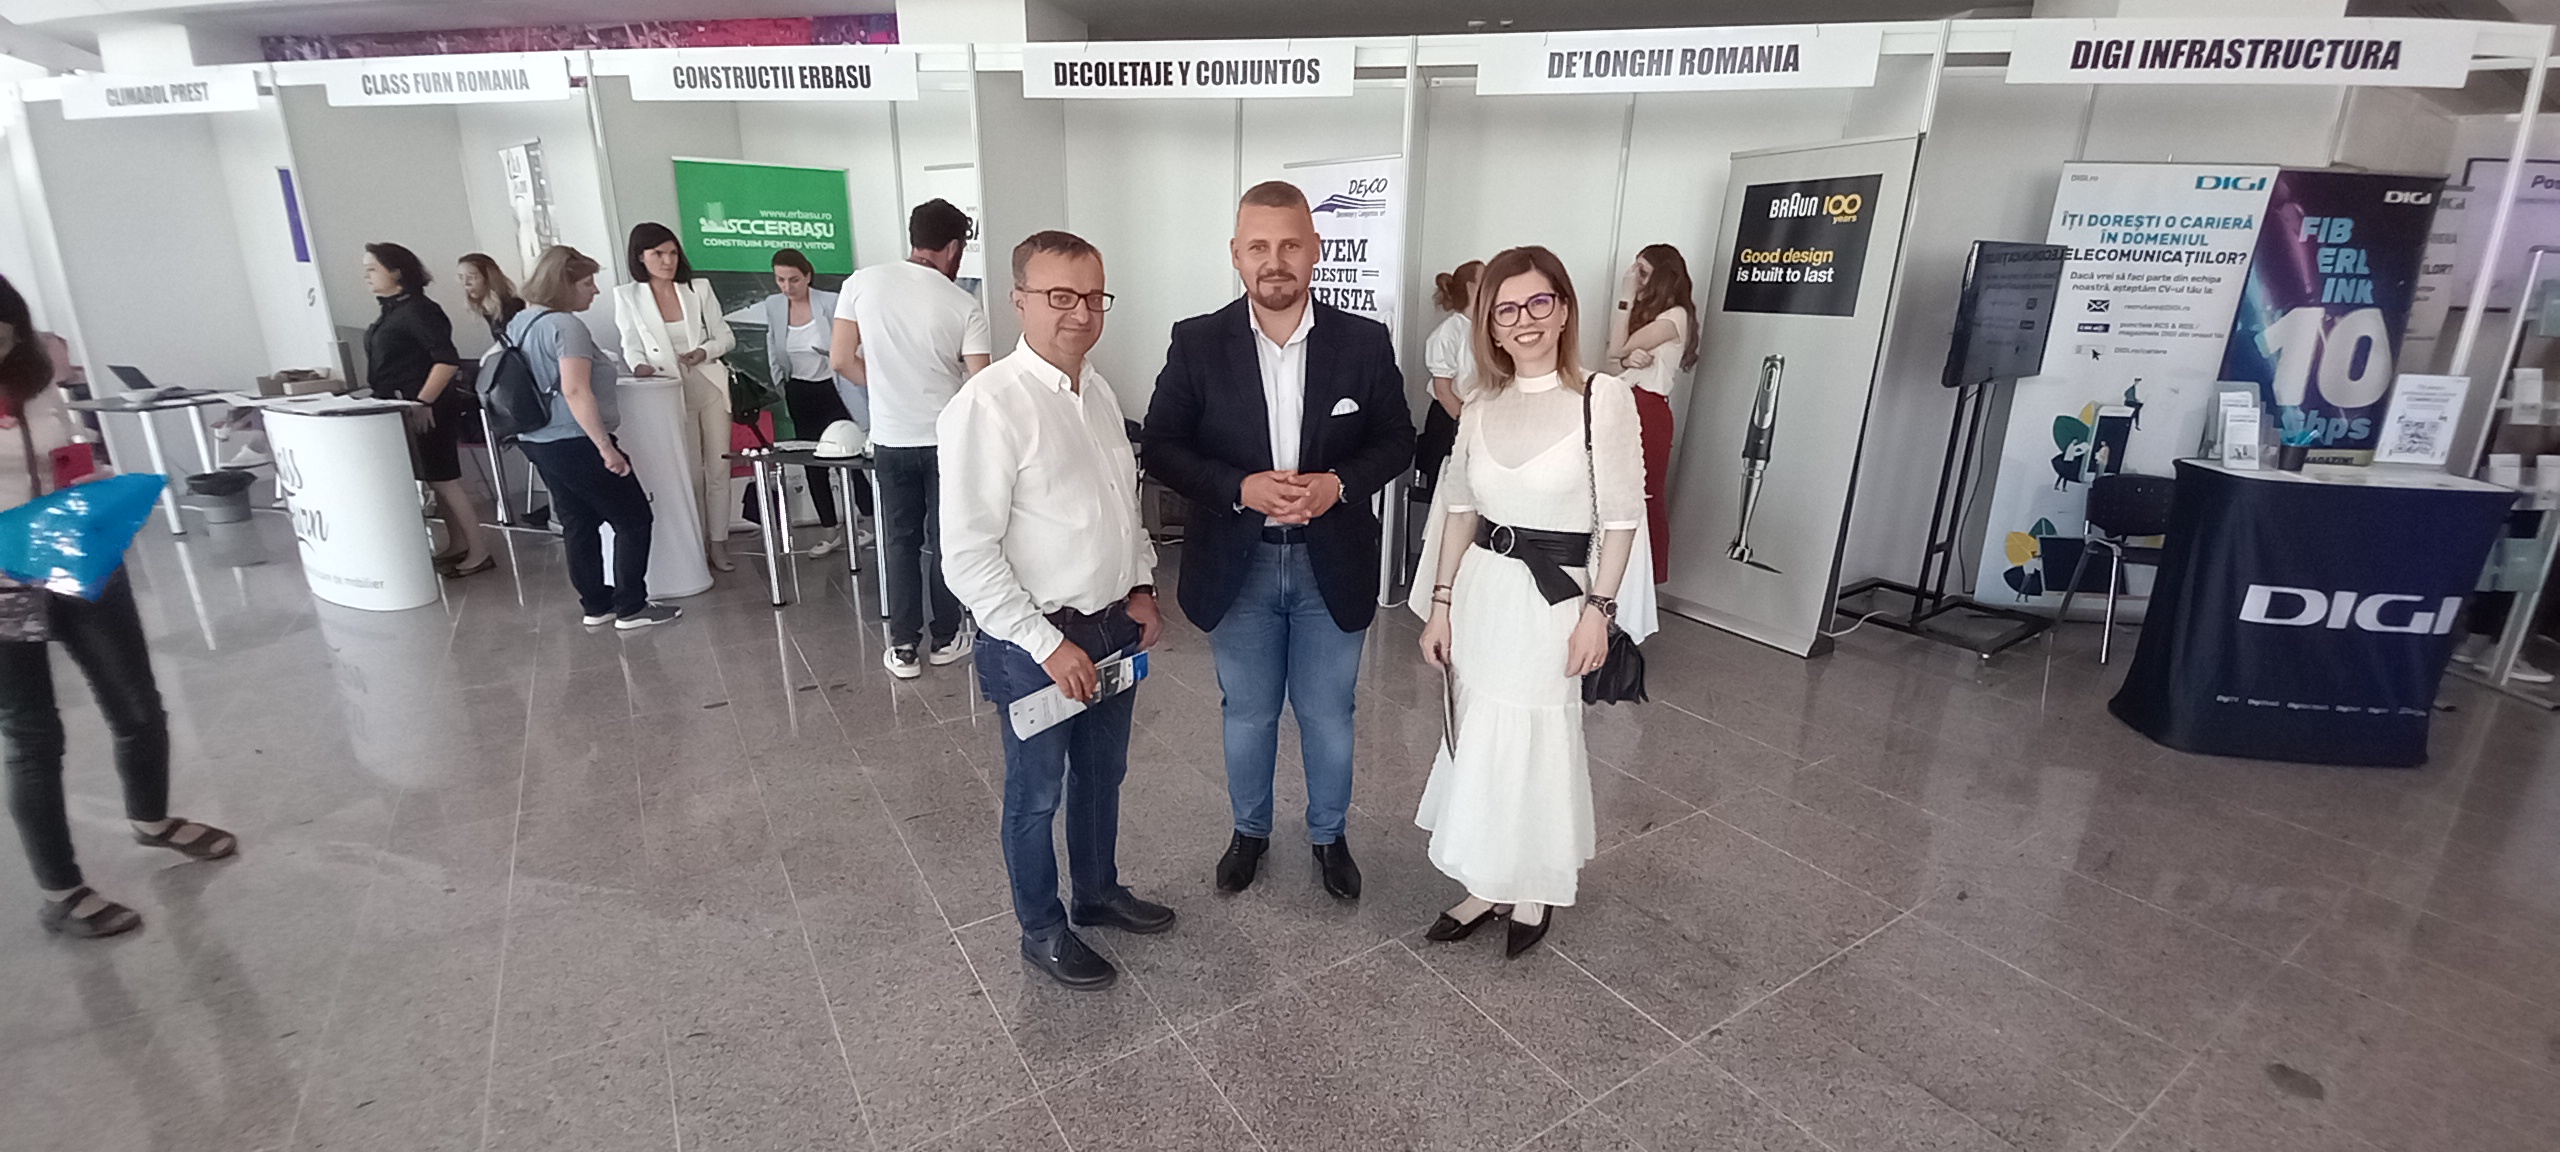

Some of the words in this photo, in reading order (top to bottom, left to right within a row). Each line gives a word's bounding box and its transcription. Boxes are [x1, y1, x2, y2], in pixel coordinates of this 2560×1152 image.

[1548, 48, 1673, 79] DE'LONGHI
[1679, 44, 1799, 75] ROMANIA
[2070, 40, 2135, 70] DIGI
[2138, 39, 2402, 70] INFRASTRUCTURA
[361, 74, 410, 96] CLASS
[413, 71, 453, 94] FURN
[456, 69, 529, 92] ROMANIA
[673, 65, 795, 89] CONSTRUCTII
[799, 64, 871, 89] ERBASU
[1054, 61, 1173, 86] DECOLETAJE
[1178, 61, 1190, 85] Y
[1195, 58, 1320, 85] CONJUNTOS
[169, 82, 209, 103] PREST
[2195, 175, 2267, 191] DIGI
[1769, 193, 1818, 218] BRAUN
[1822, 194, 1862, 215] 100
[2384, 190, 2432, 204] DIGI
[1832, 214, 1857, 224] years
[2165, 216, 2176, 228] O
[2298, 216, 2354, 244] FIB
[703, 238, 761, 248] CONSTRUIM
[764, 240, 802, 249] PENTRU
[804, 242, 835, 250] VIITOR
[1320, 238, 1368, 262] VEM
[2122, 232, 2209, 246] DOMENIUL
[1741, 249, 1780, 264] Good
[1782, 248, 1833, 266] design
[2064, 247, 2247, 267] ELECOMUNICAȚIILOR?
[2317, 247, 2370, 275] ERL
[1736, 267, 1749, 281] is
[1751, 267, 1783, 282] built
[1785, 268, 1801, 282] to
[1803, 267, 1835, 283] last
[2096, 272, 2114, 280] vrei
[2127, 273, 2145, 281] faci
[2146, 274, 2171, 282] parte
[2173, 274, 2188, 282] din
[2191, 275, 2222, 284] echipa
[2158, 285, 2185, 293] CV-ul
[2321, 278, 2374, 304] INK
[2254, 307, 2392, 408] 10
[2239, 584, 2463, 635] DIGI
